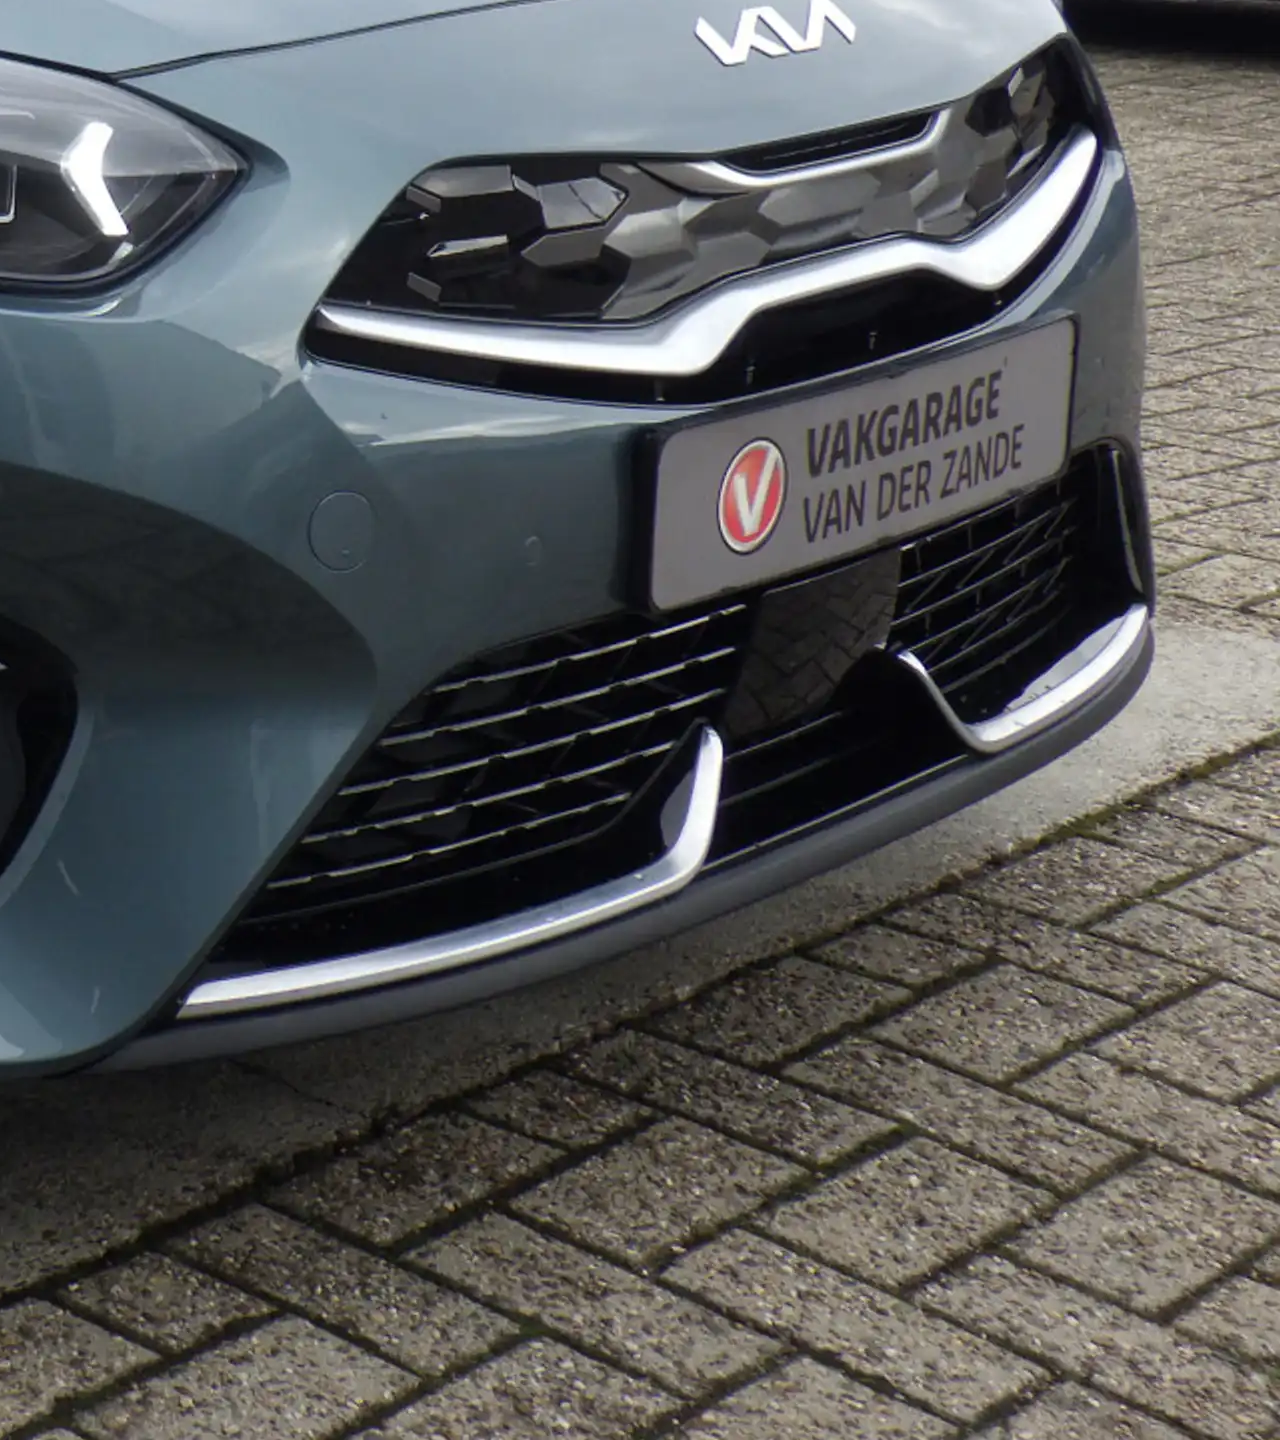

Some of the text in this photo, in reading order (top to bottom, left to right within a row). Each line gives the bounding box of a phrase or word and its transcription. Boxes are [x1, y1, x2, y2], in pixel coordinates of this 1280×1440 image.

[806, 370, 1002, 478] VAKGARAGE
[732, 445, 781, 537] V
[803, 424, 1024, 543] VAN DER ZANDE
